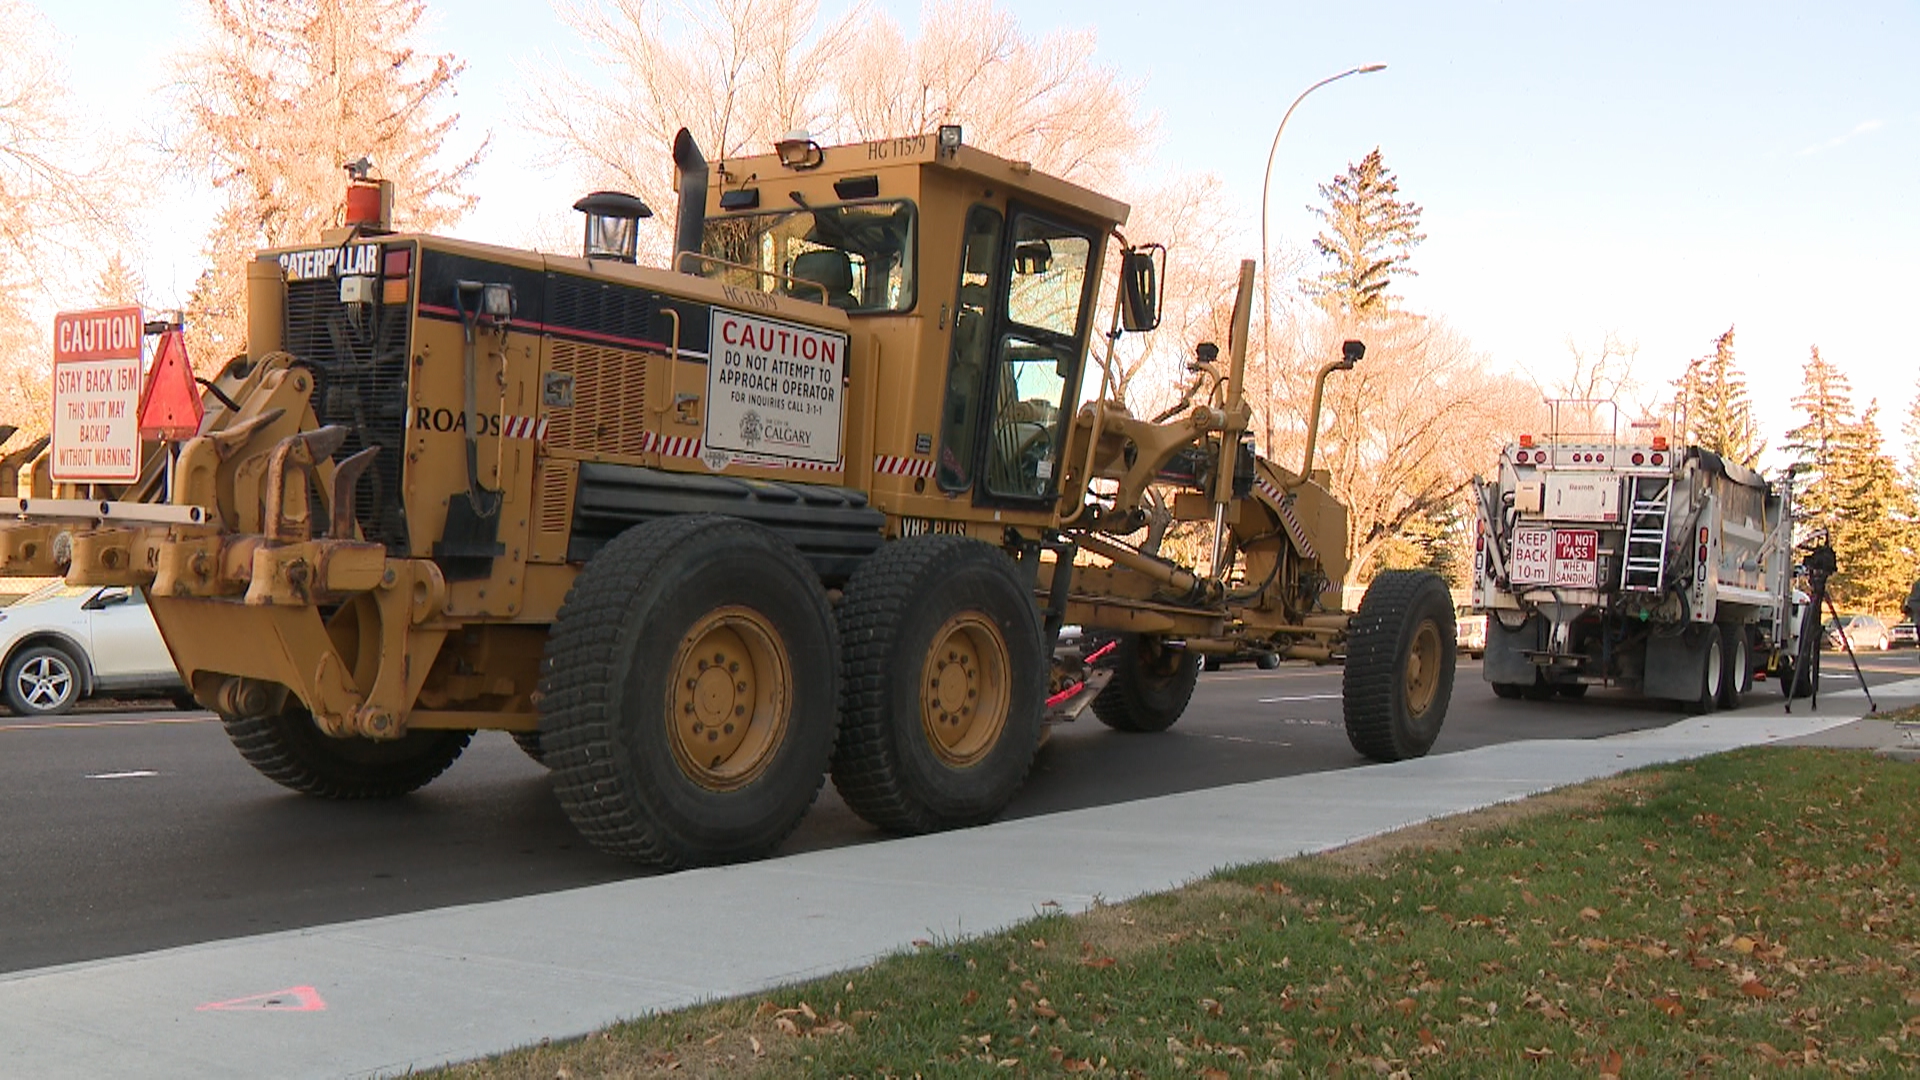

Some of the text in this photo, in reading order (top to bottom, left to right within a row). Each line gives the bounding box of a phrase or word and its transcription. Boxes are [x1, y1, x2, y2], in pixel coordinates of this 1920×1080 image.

[868, 135, 926, 160] HG 11579
[722, 285, 744, 304] HG
[60, 315, 137, 353] CAUTION
[722, 319, 836, 364] CAUTION
[725, 350, 831, 384] DO NOT ATTEMPT TO
[59, 367, 137, 394] STAY BACK 15M
[719, 369, 835, 402] APPROACH OPERATOR
[68, 401, 125, 420] THIS UNIT MAY
[731, 391, 745, 403] FOR
[748, 393, 785, 410] INQUIRIES
[788, 400, 803, 413] CALL
[80, 425, 110, 443] BACKUP
[764, 425, 811, 444] CALGARY
[59, 448, 131, 467] WITHOUT WARNING
[903, 518, 929, 538] VHP
[1518, 532, 1547, 546] KEEP
[1557, 533, 1594, 546] DO NOT
[1516, 549, 1547, 562] BACK
[1562, 546, 1588, 558] PASS
[1562, 561, 1587, 572] WHEN
[1556, 572, 1592, 584] SANDING
